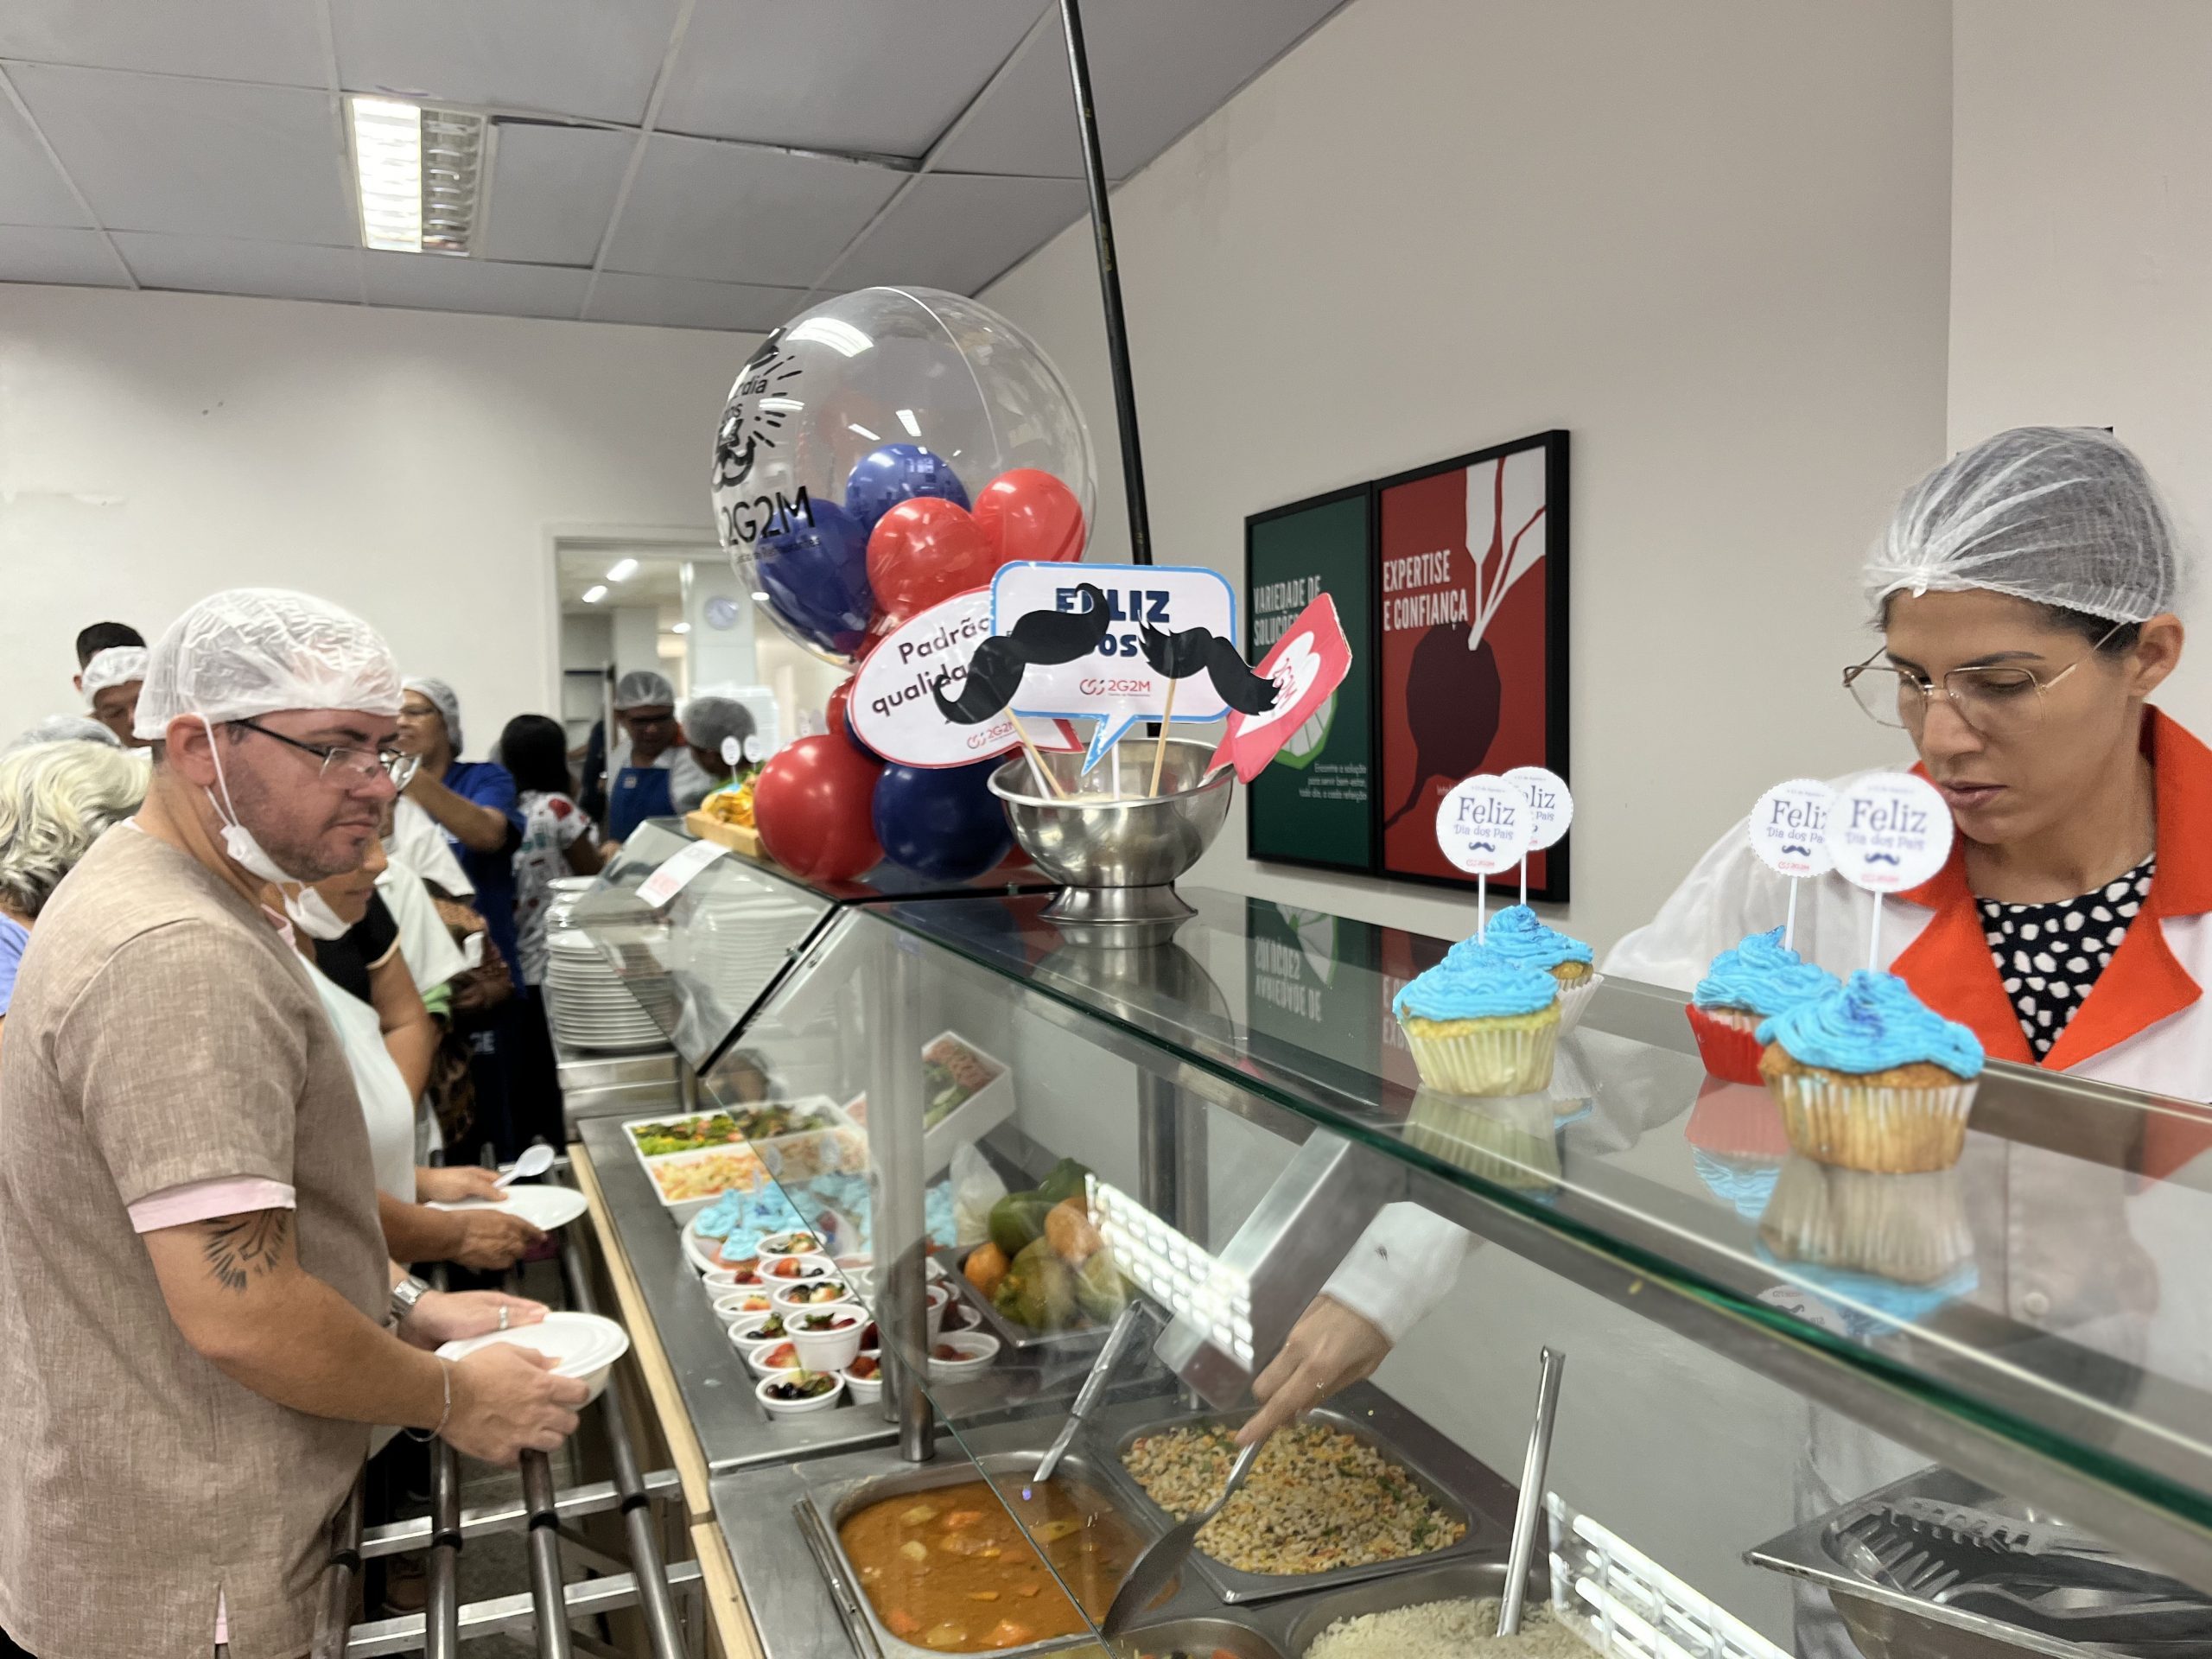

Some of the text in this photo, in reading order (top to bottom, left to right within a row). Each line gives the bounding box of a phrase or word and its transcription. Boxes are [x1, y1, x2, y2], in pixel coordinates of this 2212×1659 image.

[721, 486, 816, 543] 2G2M
[1383, 550, 1451, 593] EXPERTISE
[1254, 575, 1321, 614] VARIEDADE DE
[1384, 588, 1468, 632] E CONFIANÇA
[872, 664, 967, 716] qualida
[1108, 679, 1151, 692] 2G2M
[1457, 796, 1516, 826] Feliz
[1524, 785, 1555, 810] liz
[1536, 810, 1555, 821] Pais
[1850, 798, 1928, 835] Feliz
[1453, 823, 1514, 840] Dia dos Pais
[1765, 826, 1826, 844] Dia dos Pa
[1844, 830, 1926, 851] Dia dos Pais
